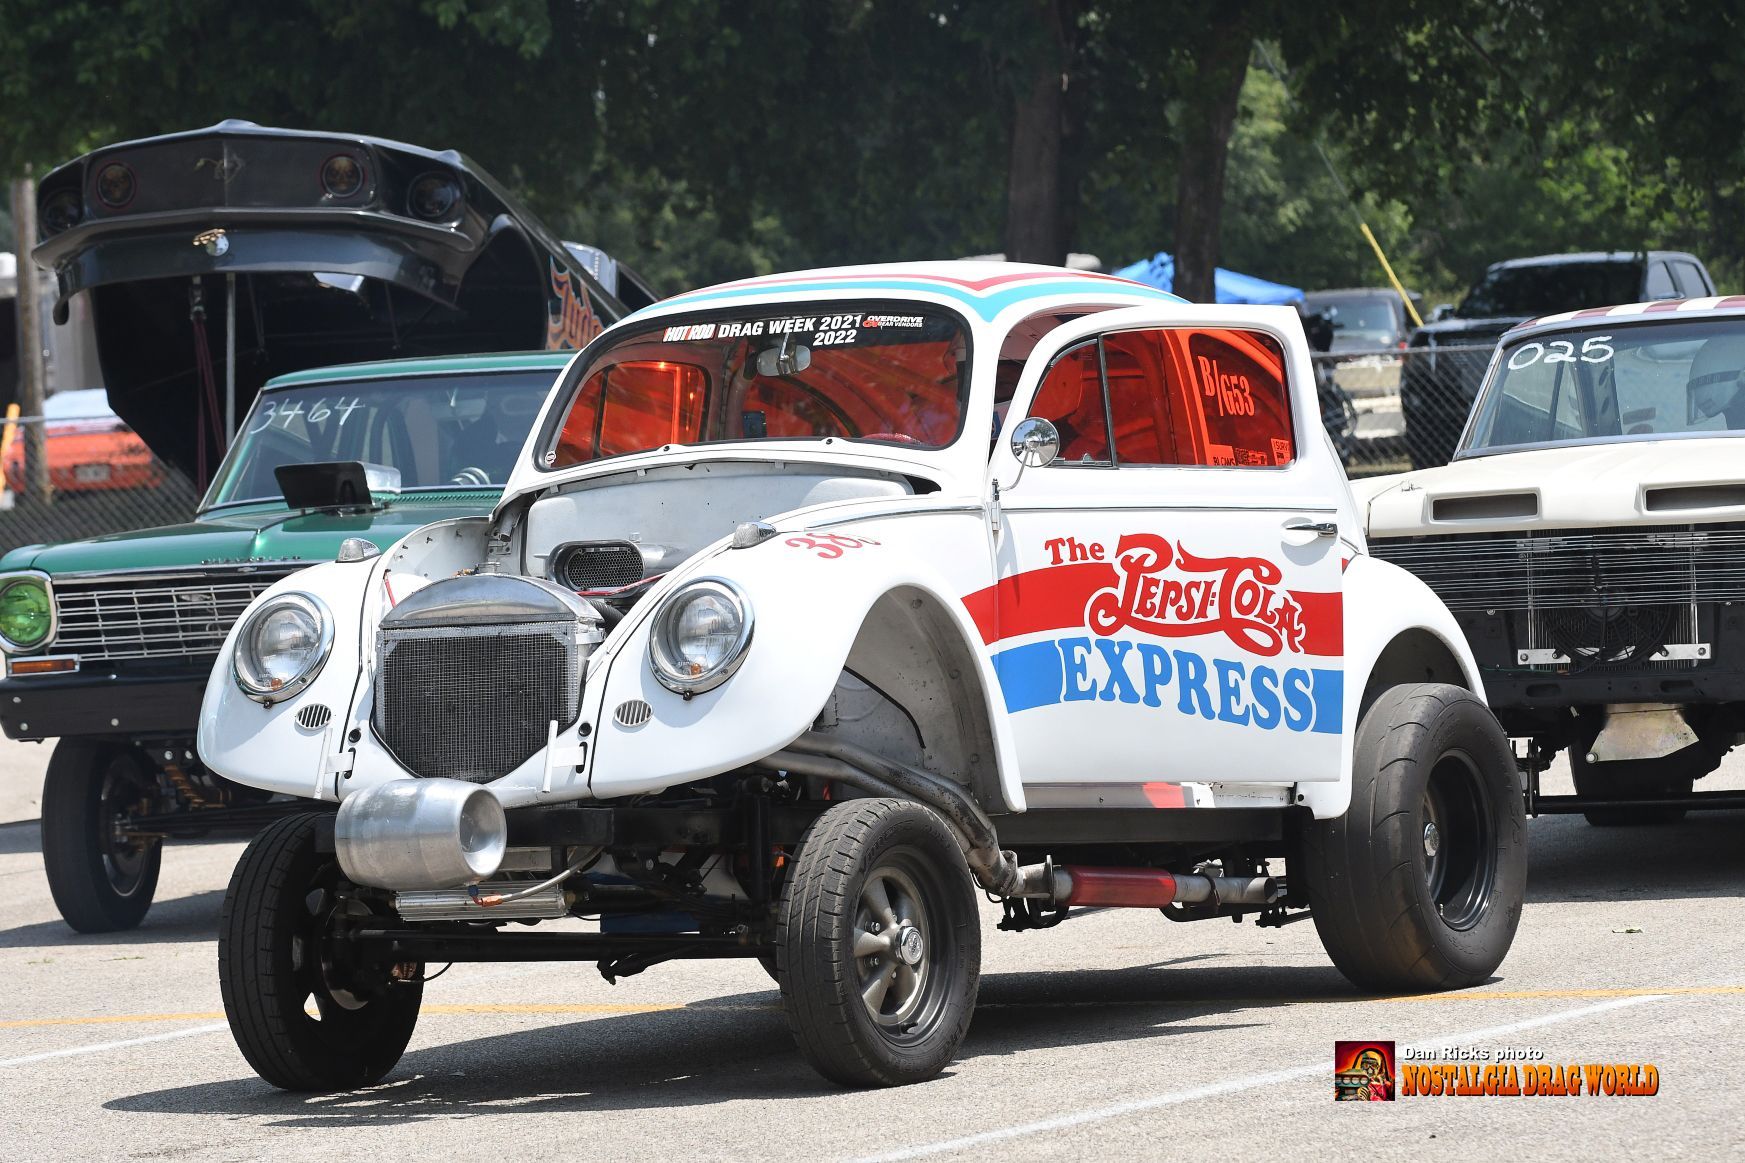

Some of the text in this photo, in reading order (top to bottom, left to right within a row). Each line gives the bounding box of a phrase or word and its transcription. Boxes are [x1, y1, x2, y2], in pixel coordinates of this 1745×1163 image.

[663, 314, 863, 342] HOT ROD DRAG WEEK 2021
[867, 315, 924, 323] OVERDRIVE
[813, 330, 856, 346] 2022
[1508, 336, 1614, 370] 025
[1197, 355, 1255, 416] B/G53
[250, 396, 366, 434] 3464
[1044, 536, 1105, 565] The
[1058, 636, 1313, 732] EXPRESS
